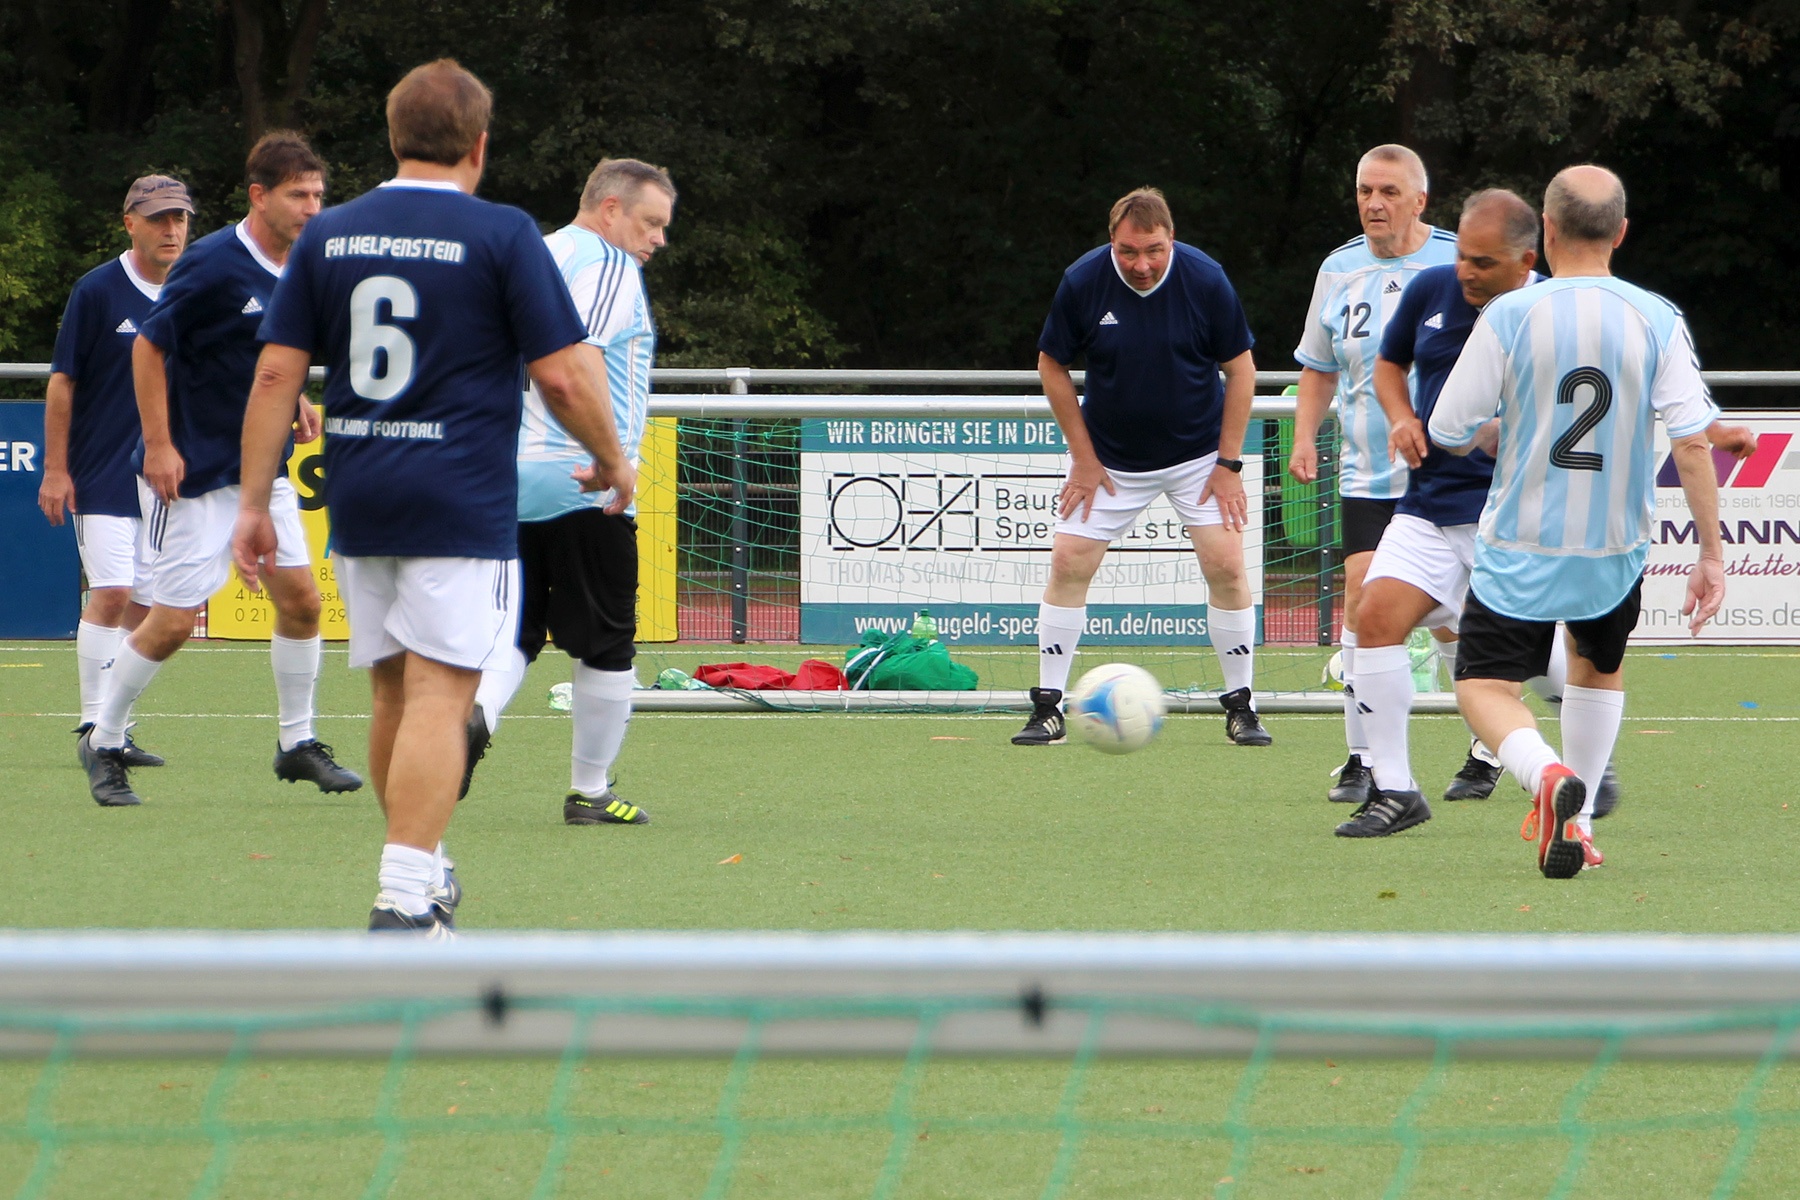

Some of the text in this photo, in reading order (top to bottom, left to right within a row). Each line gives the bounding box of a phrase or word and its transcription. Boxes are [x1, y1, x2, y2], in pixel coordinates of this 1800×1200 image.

[347, 236, 461, 262] HELPENSTEIN
[1340, 302, 1372, 340] 12
[350, 275, 417, 400] 6
[372, 421, 443, 439] FOOTBALL
[1550, 366, 1613, 472] 2
[826, 421, 865, 445] WIR
[870, 421, 956, 445] BRINGEN
[962, 421, 992, 445] SIE
[997, 421, 1018, 445] IN
[1024, 421, 1056, 445] DIE
[1732, 495, 1761, 508] seit
[1766, 494, 1800, 509] 196
[827, 561, 904, 584] THOMAS
[911, 561, 994, 585] SCHMITZ
